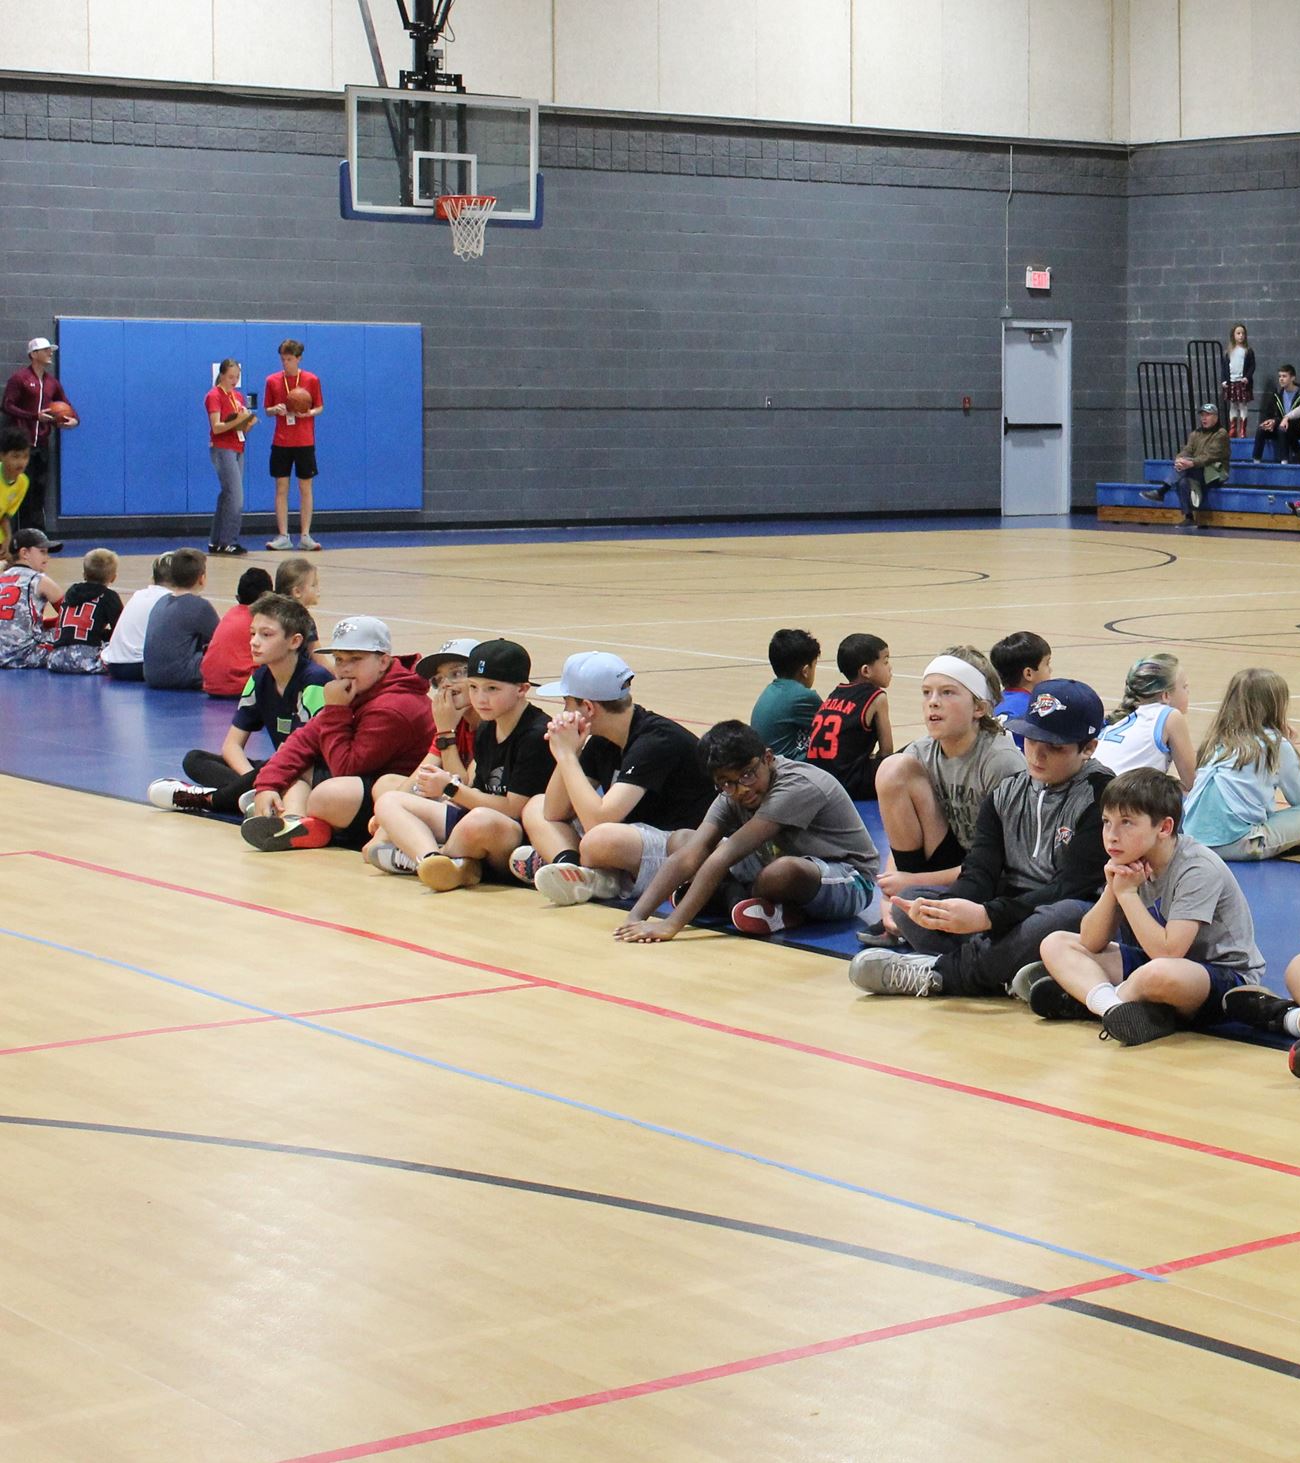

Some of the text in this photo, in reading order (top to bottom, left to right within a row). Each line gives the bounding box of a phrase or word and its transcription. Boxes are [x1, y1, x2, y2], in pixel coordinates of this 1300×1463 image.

[56, 602, 97, 641] 4
[821, 698, 856, 715] RDAN
[807, 714, 842, 760] 23
